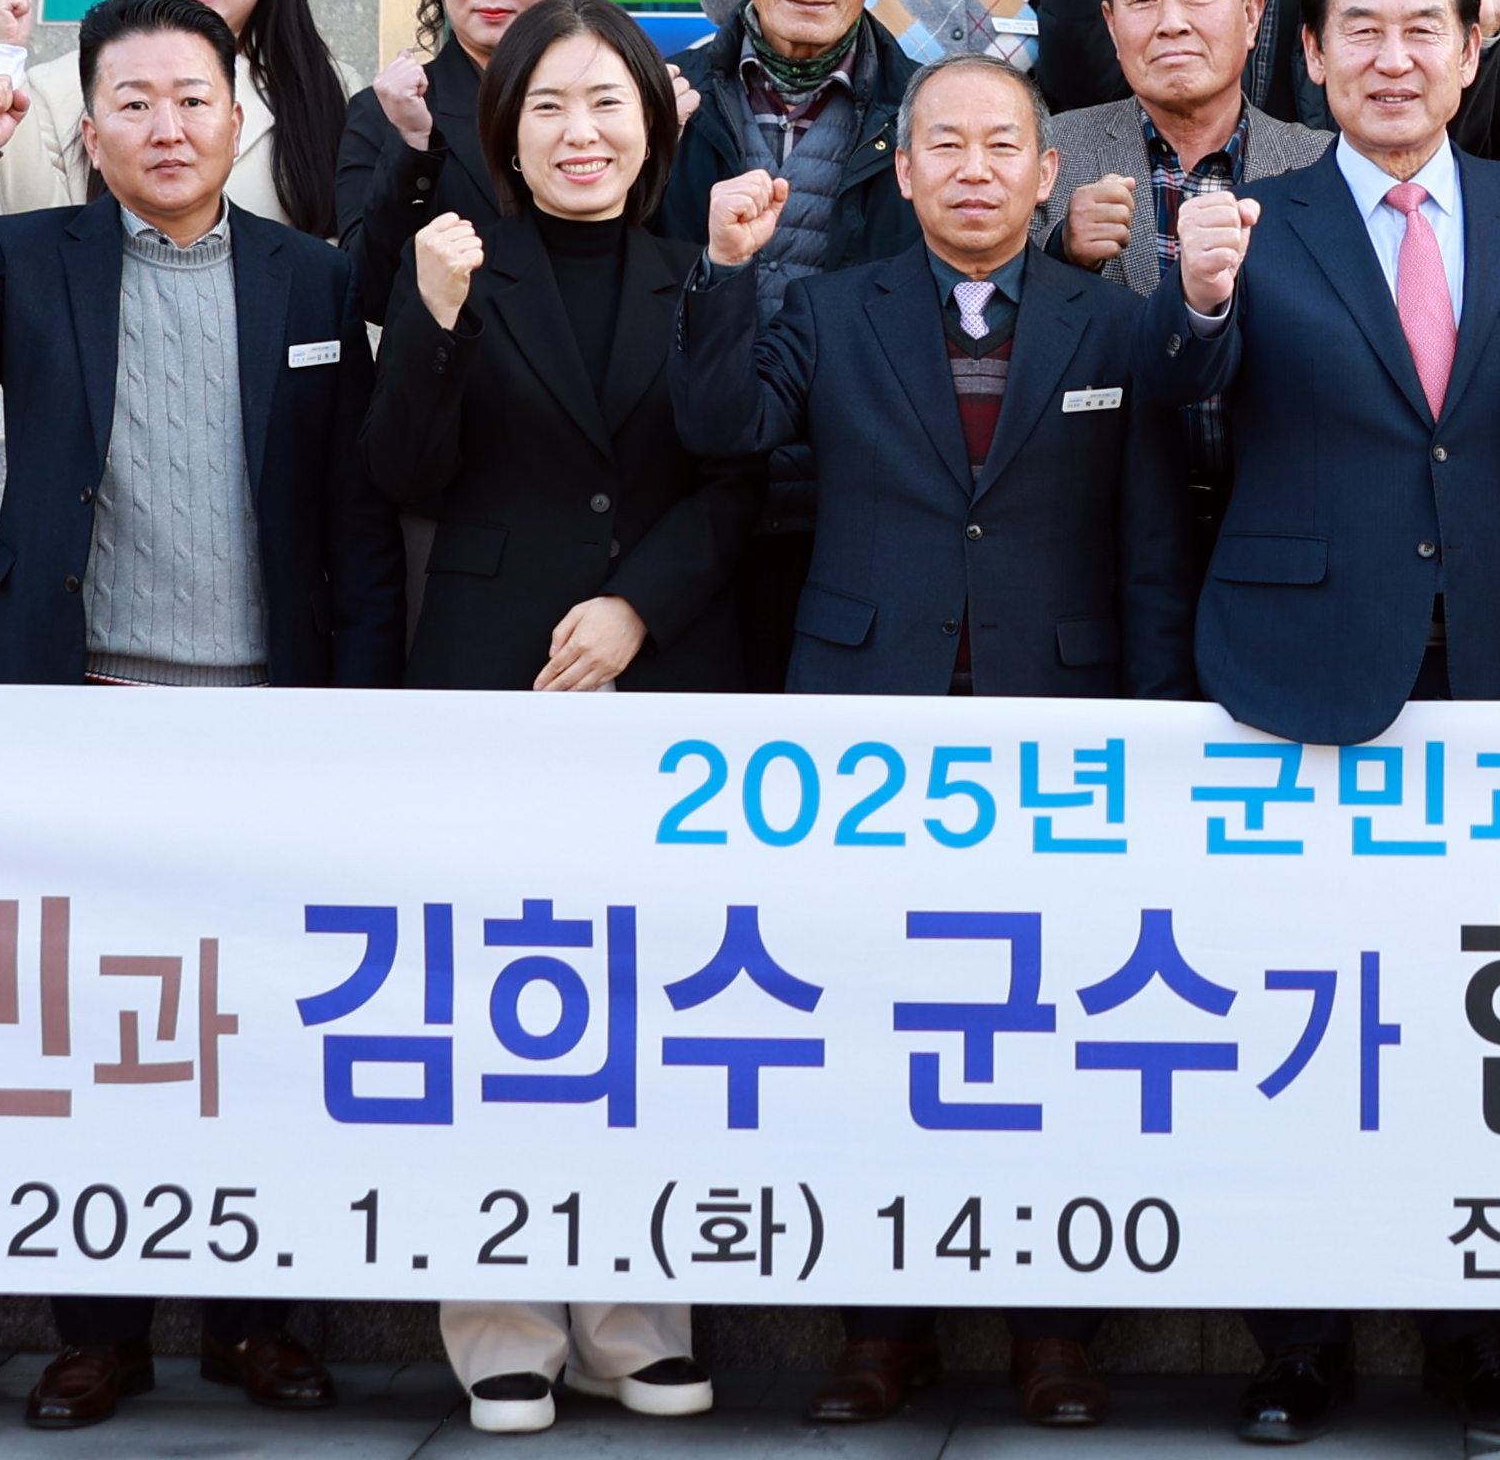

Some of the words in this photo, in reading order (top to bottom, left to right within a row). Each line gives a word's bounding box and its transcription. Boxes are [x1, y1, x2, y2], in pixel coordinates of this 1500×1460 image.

[657, 739, 1127, 855] 2025년
[295, 898, 825, 1128] 김희수
[892, 908, 1402, 1133] 군수가
[6, 1182, 293, 1268] 2025.
[350, 1189, 429, 1270] 1.
[476, 1181, 825, 1280] 21.(화)
[876, 1195, 1181, 1273] 14:00
